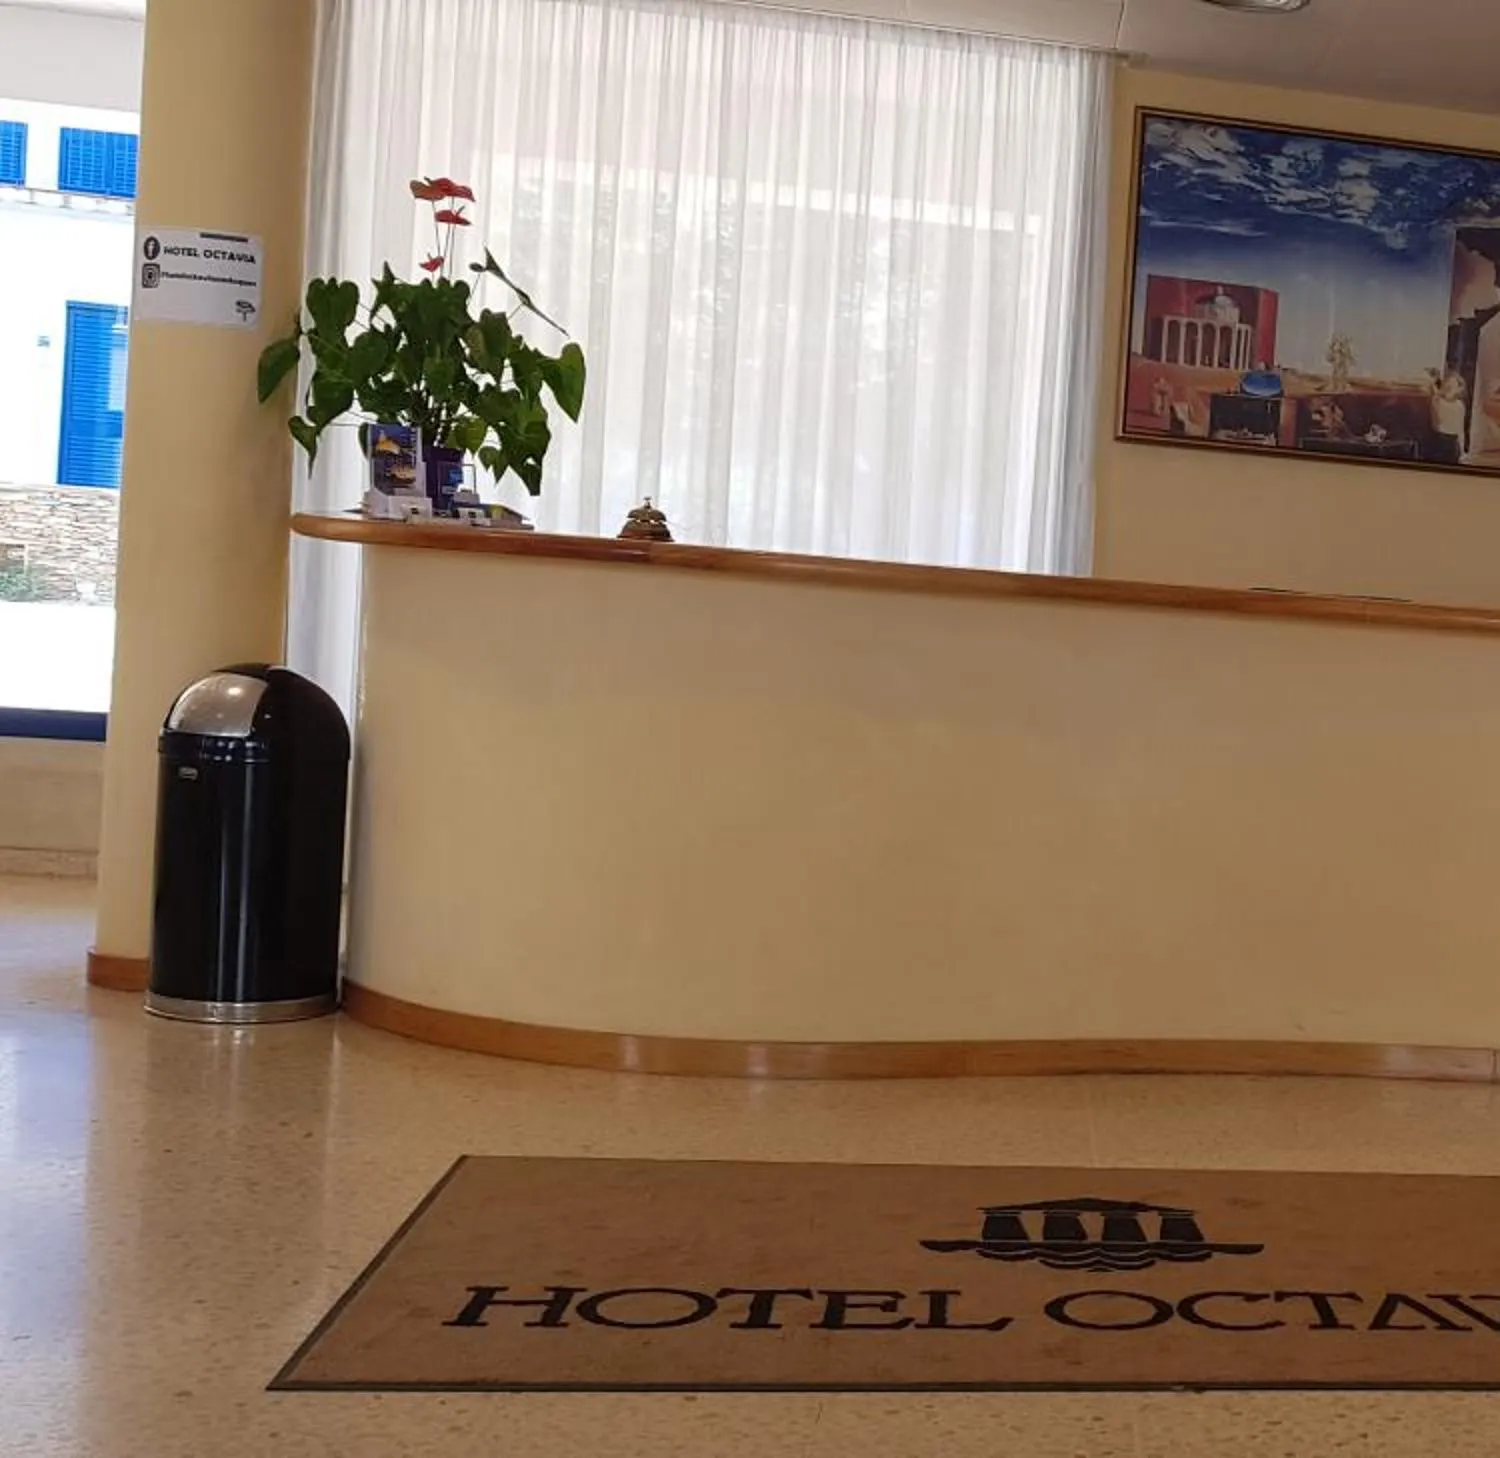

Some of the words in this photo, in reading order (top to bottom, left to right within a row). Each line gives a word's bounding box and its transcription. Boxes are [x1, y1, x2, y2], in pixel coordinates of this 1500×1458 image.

[163, 246, 200, 258] HOTEL
[203, 250, 256, 264] OCTAVIA
[441, 1285, 1014, 1331] HOTEL
